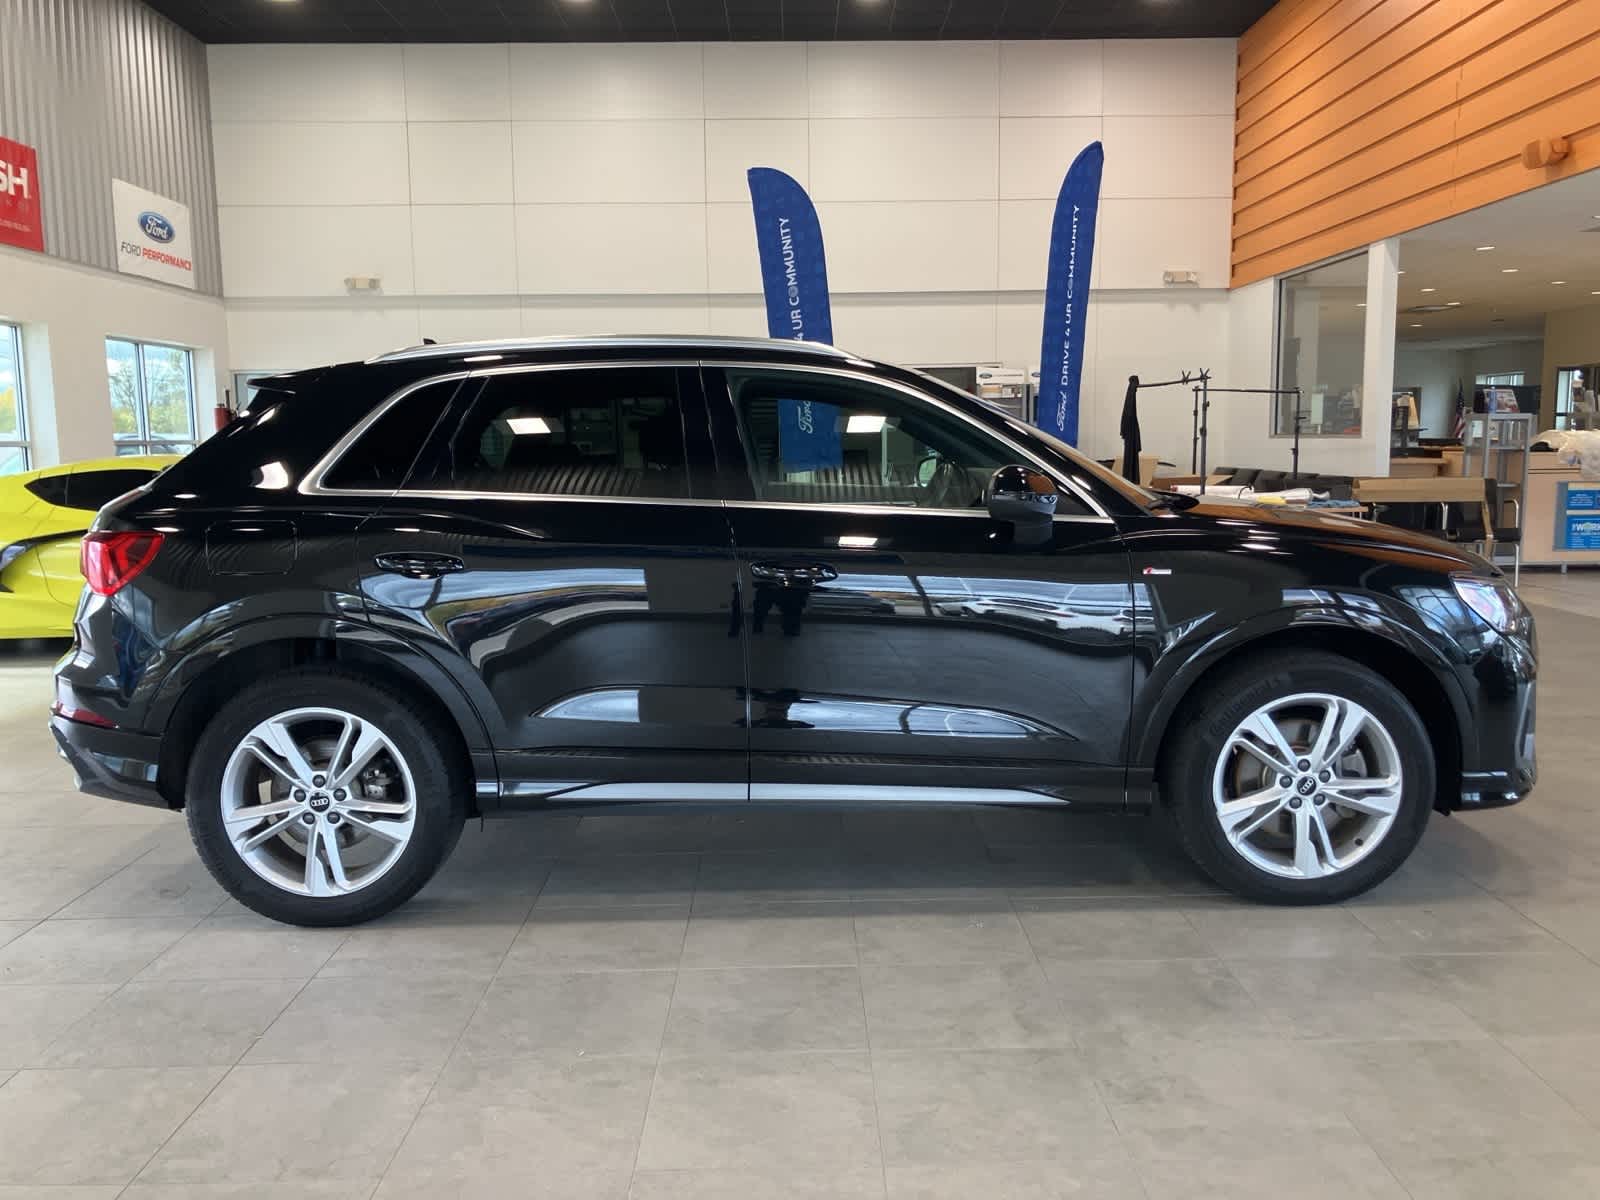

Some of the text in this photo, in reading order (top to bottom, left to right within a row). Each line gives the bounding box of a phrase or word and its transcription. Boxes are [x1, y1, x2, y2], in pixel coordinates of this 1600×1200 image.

[146, 215, 168, 239] Ford
[120, 241, 141, 257] FORD
[779, 217, 799, 306] COMMUNITY
[791, 309, 803, 330] UR
[1057, 205, 1080, 431] Ford DRIVE 4 UR COMMUNITY
